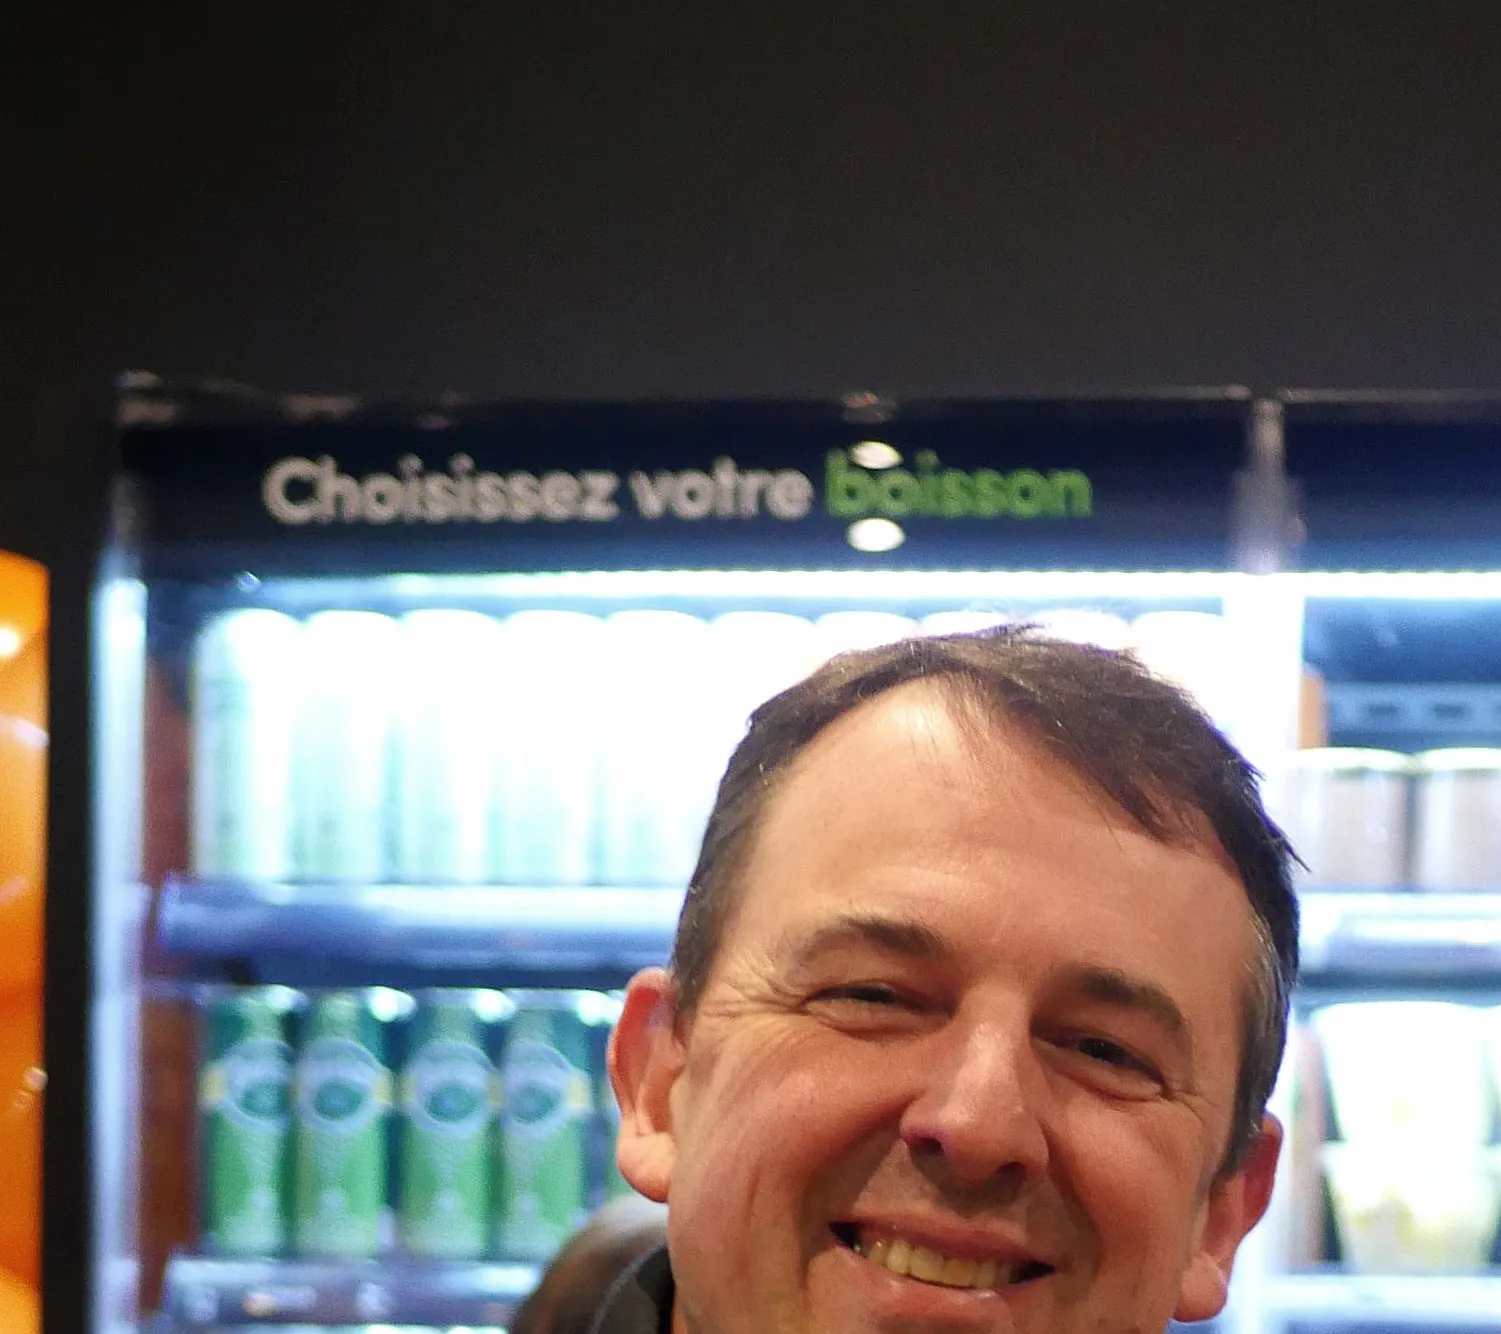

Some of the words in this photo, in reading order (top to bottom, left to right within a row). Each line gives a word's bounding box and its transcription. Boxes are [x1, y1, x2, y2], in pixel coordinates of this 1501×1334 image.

[263, 453, 620, 522] Choisissez
[628, 455, 814, 521] votre
[825, 447, 1093, 519] boisson
